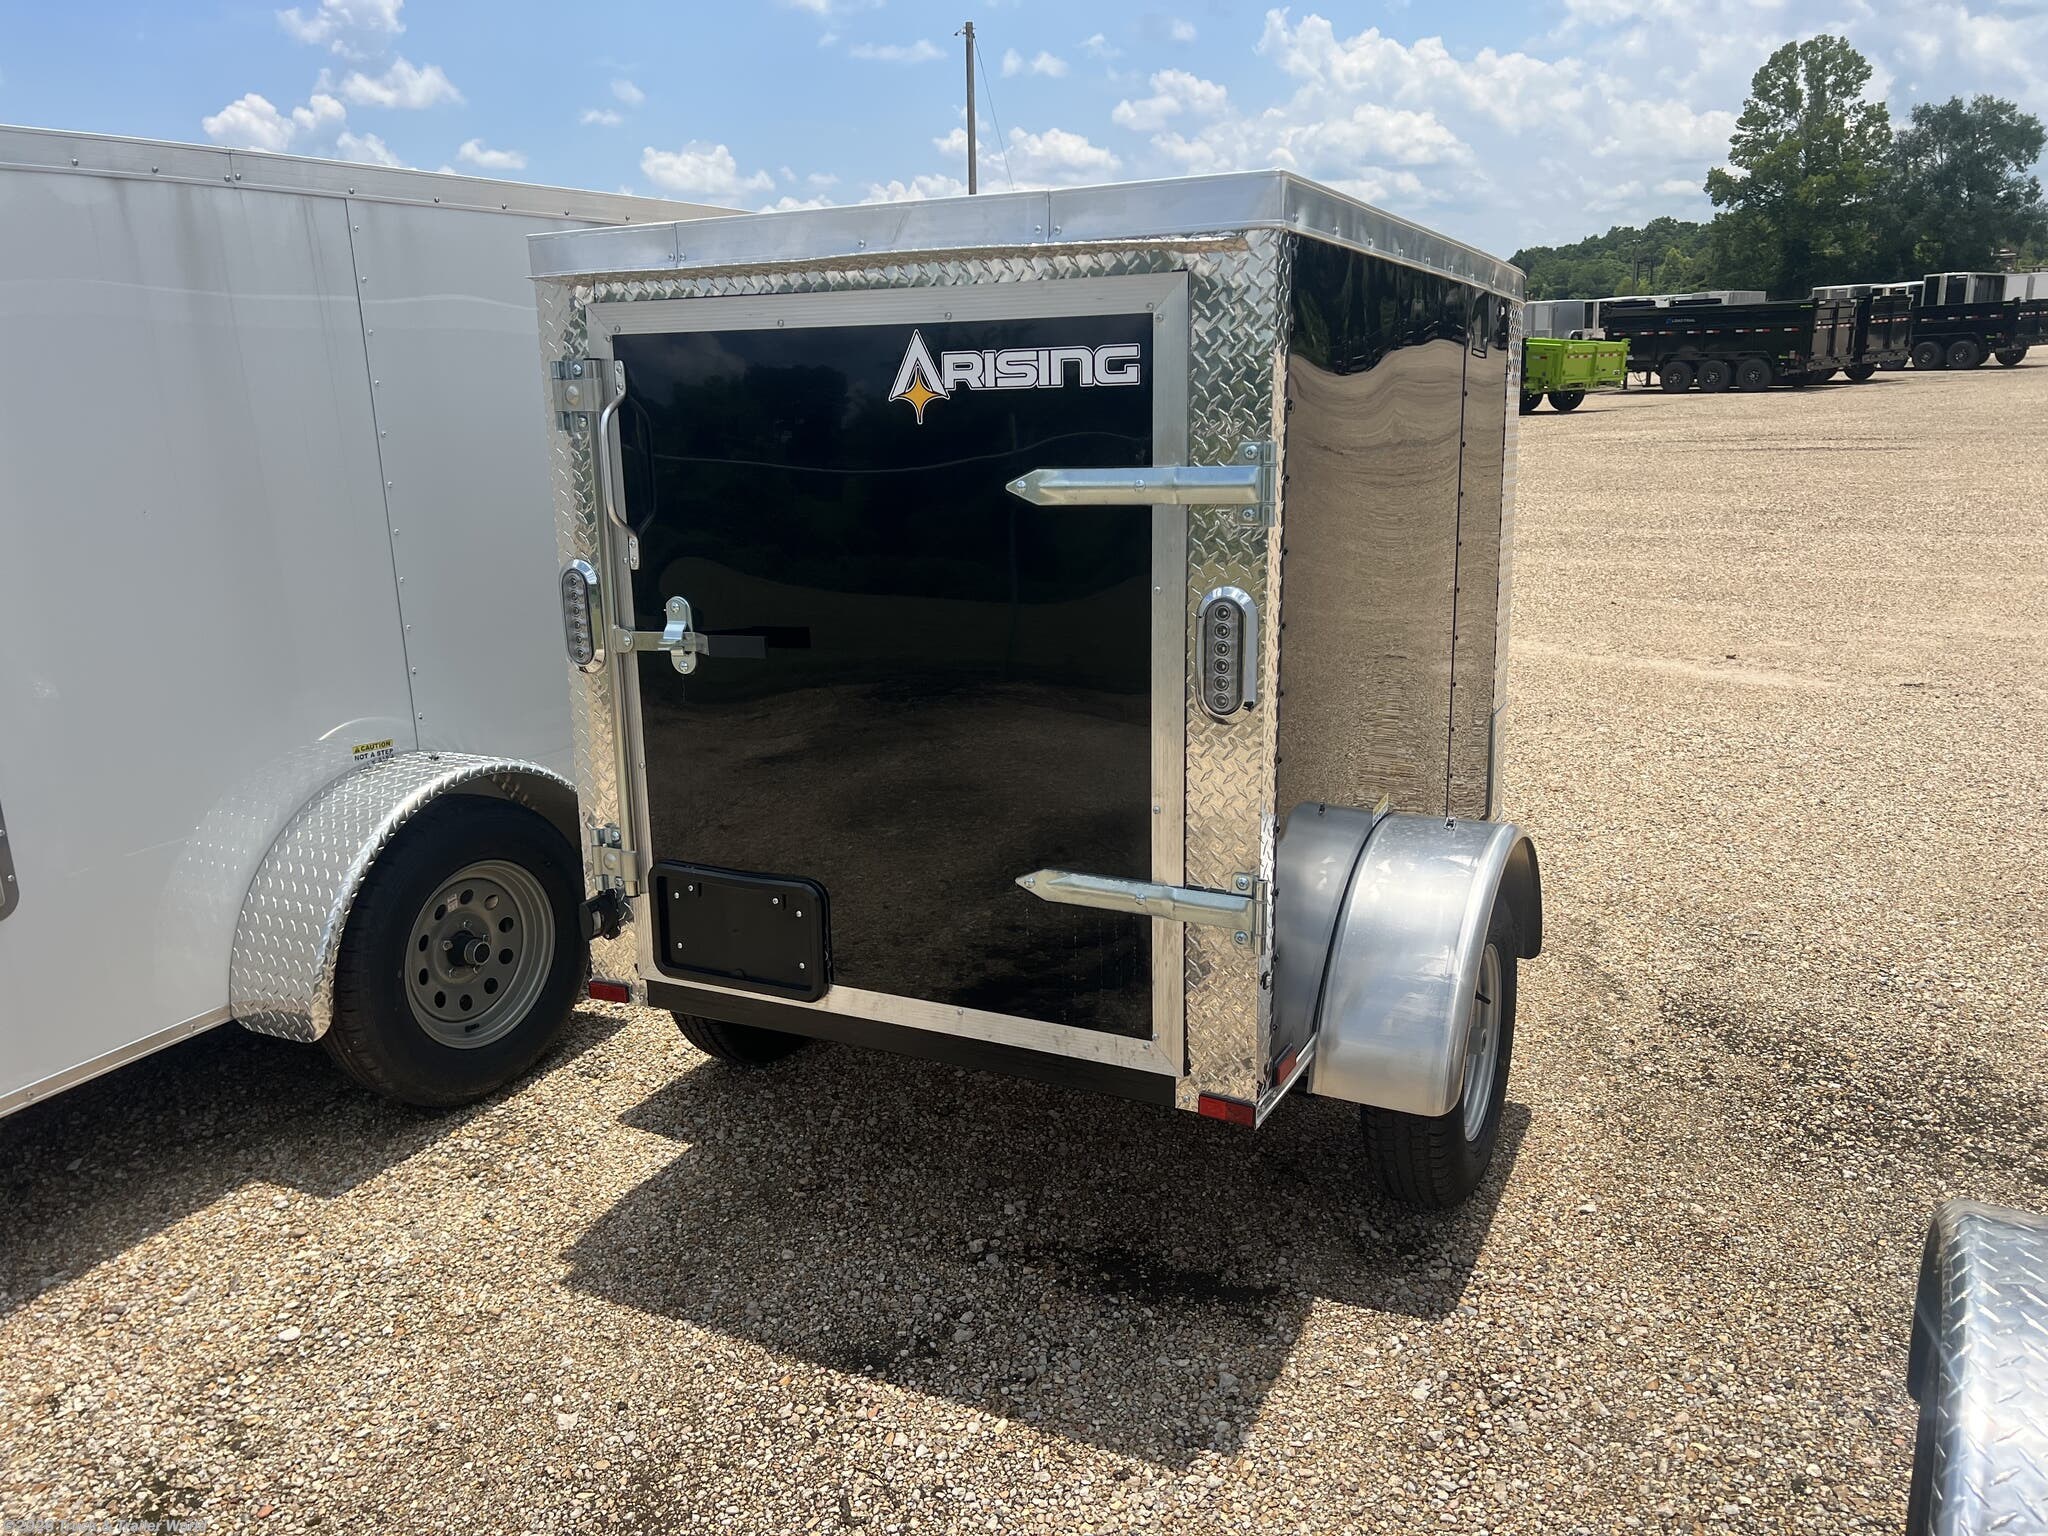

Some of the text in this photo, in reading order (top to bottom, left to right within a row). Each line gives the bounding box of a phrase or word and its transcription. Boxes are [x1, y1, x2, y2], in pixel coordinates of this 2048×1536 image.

[360, 740, 391, 752] CAUTION
[354, 752, 368, 761] NOT
[376, 748, 394, 756] STEP
